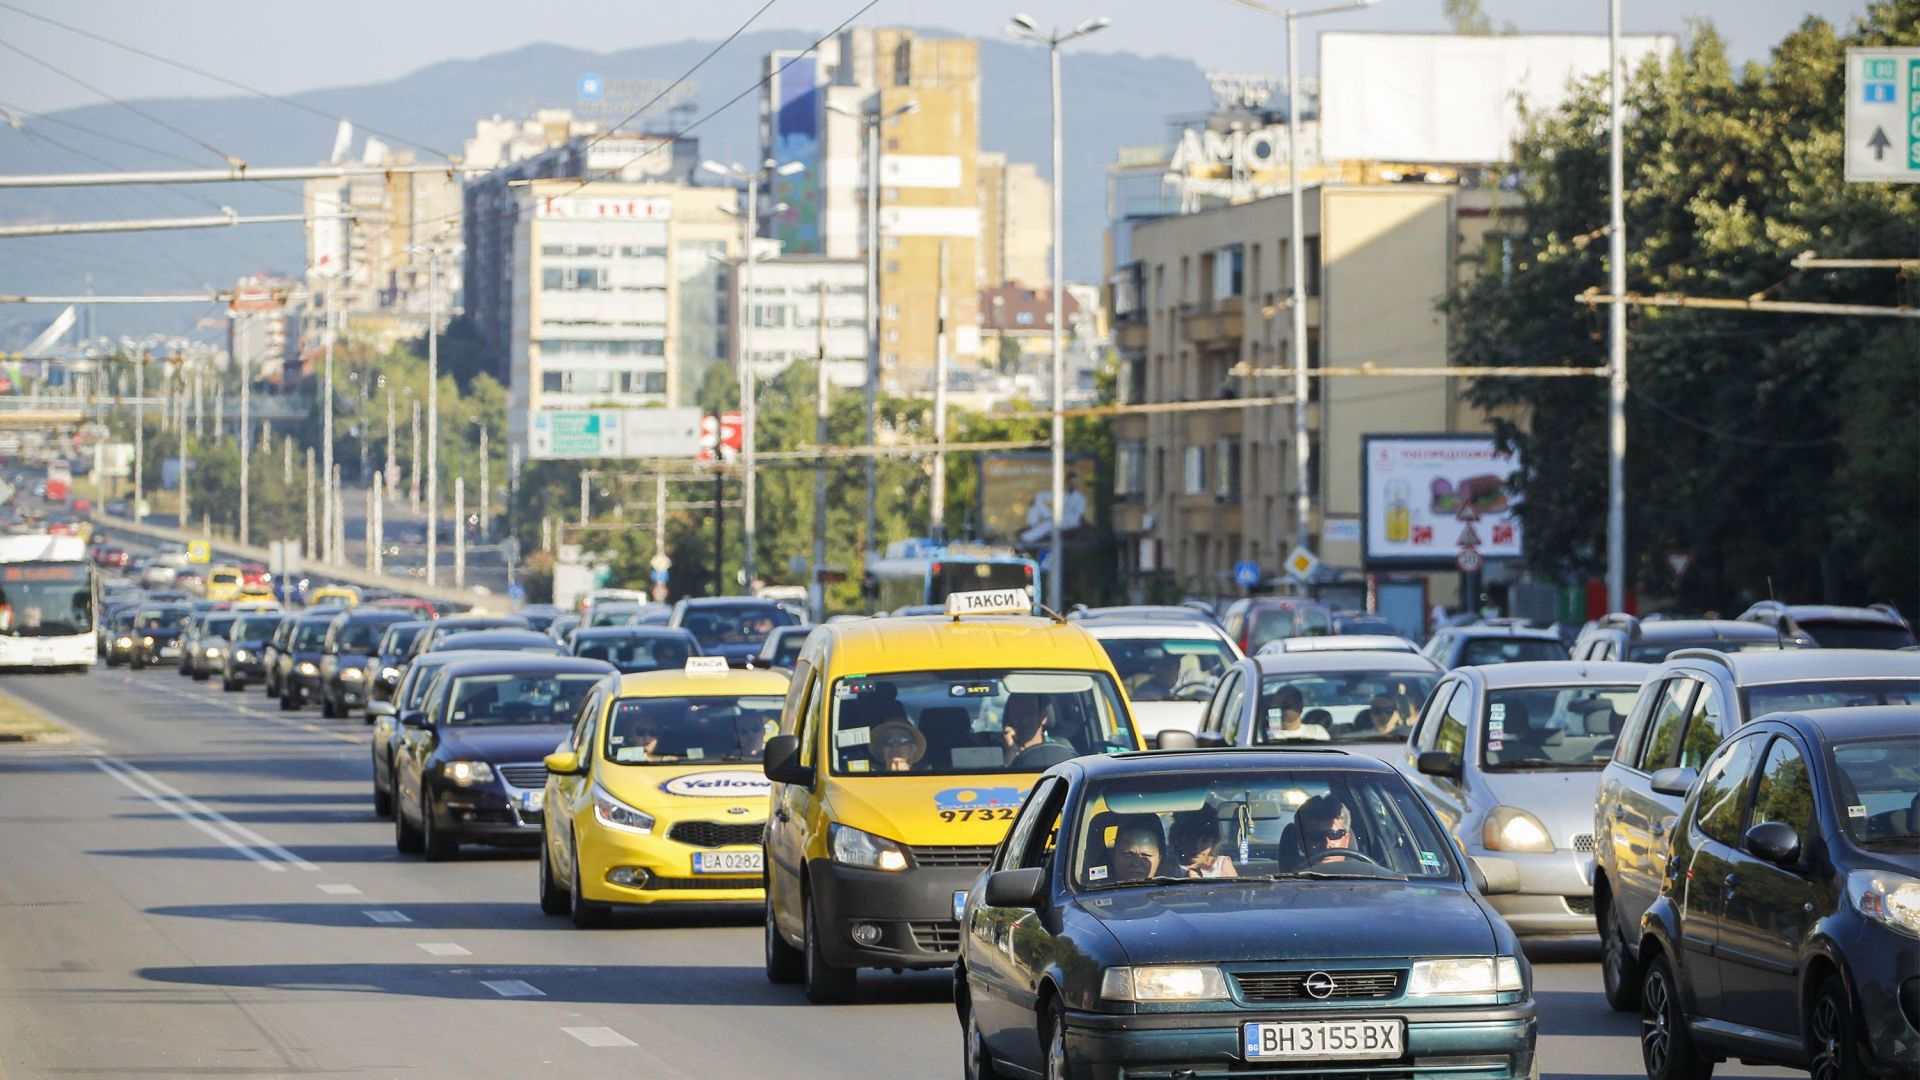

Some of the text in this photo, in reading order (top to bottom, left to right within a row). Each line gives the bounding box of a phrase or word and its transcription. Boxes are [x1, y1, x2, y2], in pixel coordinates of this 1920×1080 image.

[965, 594, 1014, 608] ТАКСИ
[683, 779, 771, 788] Yellow
[940, 808, 1014, 822] 9732
[1300, 1026, 1358, 1050] 3155
